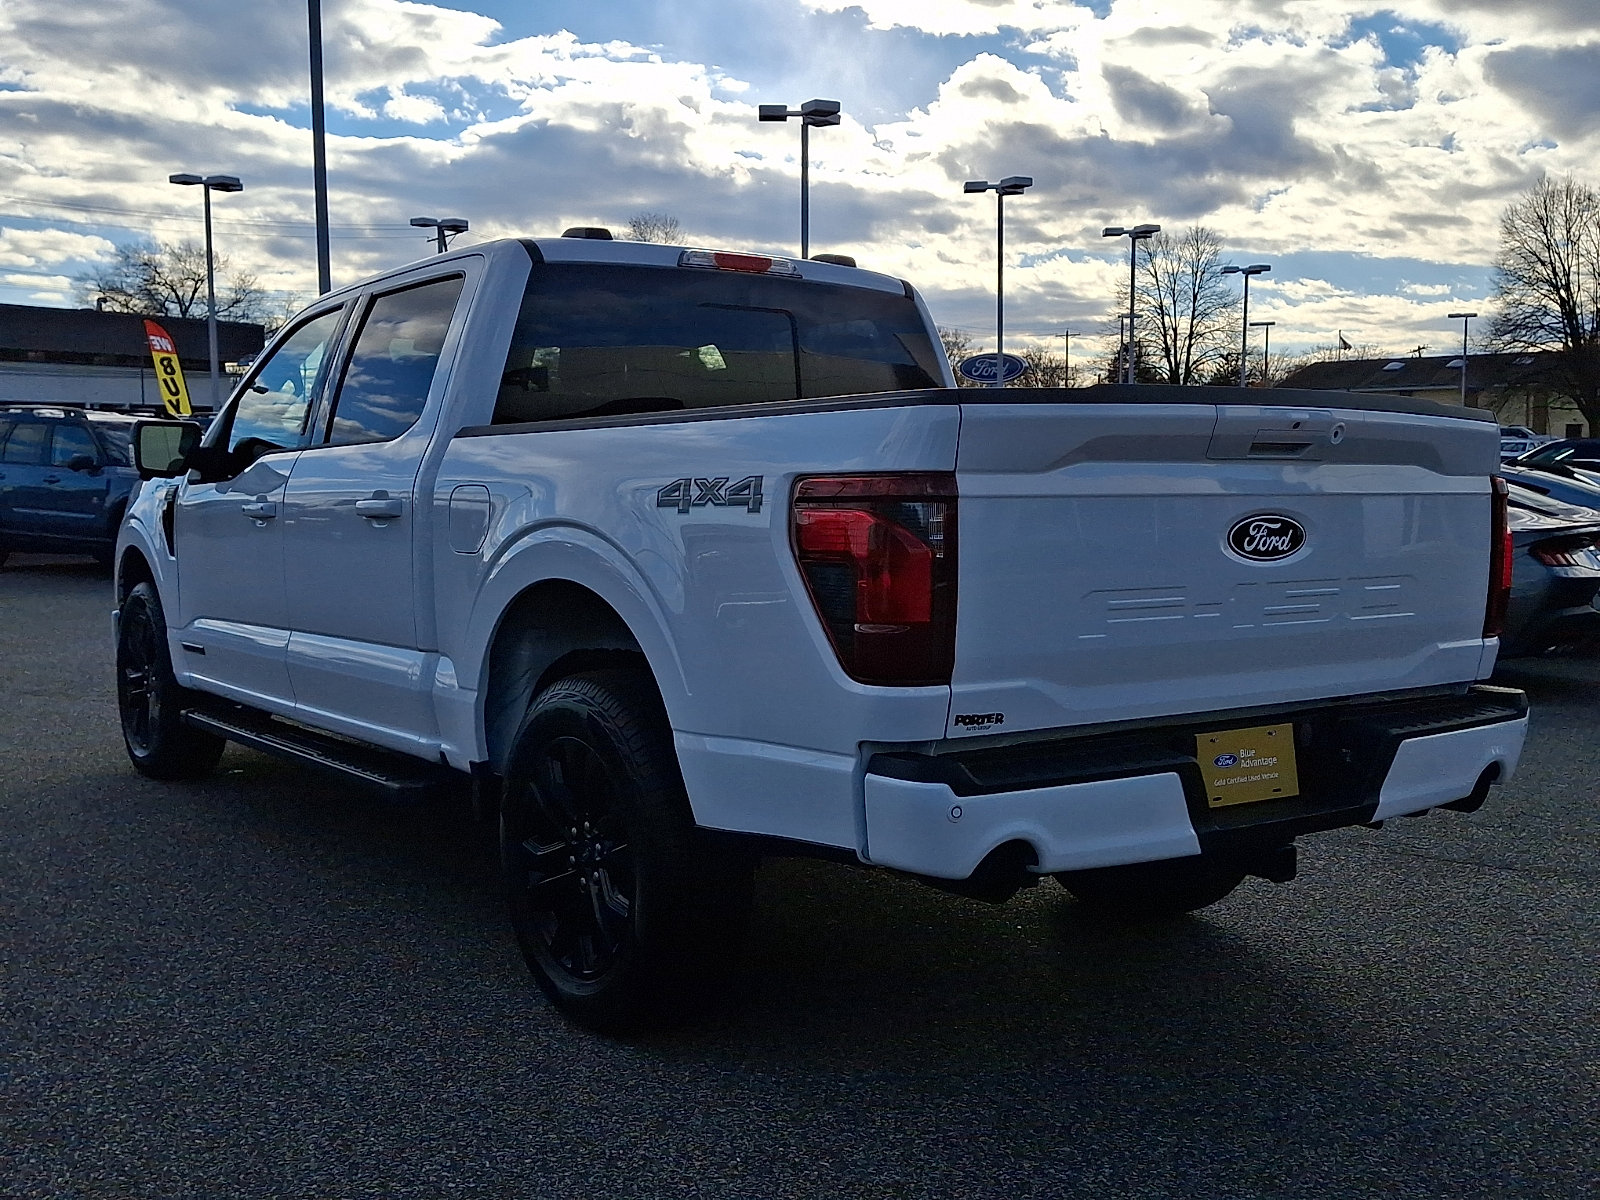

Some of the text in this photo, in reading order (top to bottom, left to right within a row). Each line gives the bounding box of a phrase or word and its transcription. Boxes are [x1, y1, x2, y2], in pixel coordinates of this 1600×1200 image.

[1243, 521, 1293, 552] Ford
[954, 713, 1005, 726] PORTER
[1240, 749, 1255, 758] Blue
[1217, 755, 1234, 766] Ford
[1240, 757, 1278, 768] Advantage
[1214, 779, 1226, 787] Gold
[1227, 776, 1248, 785] Certified
[1248, 773, 1261, 782] Used
